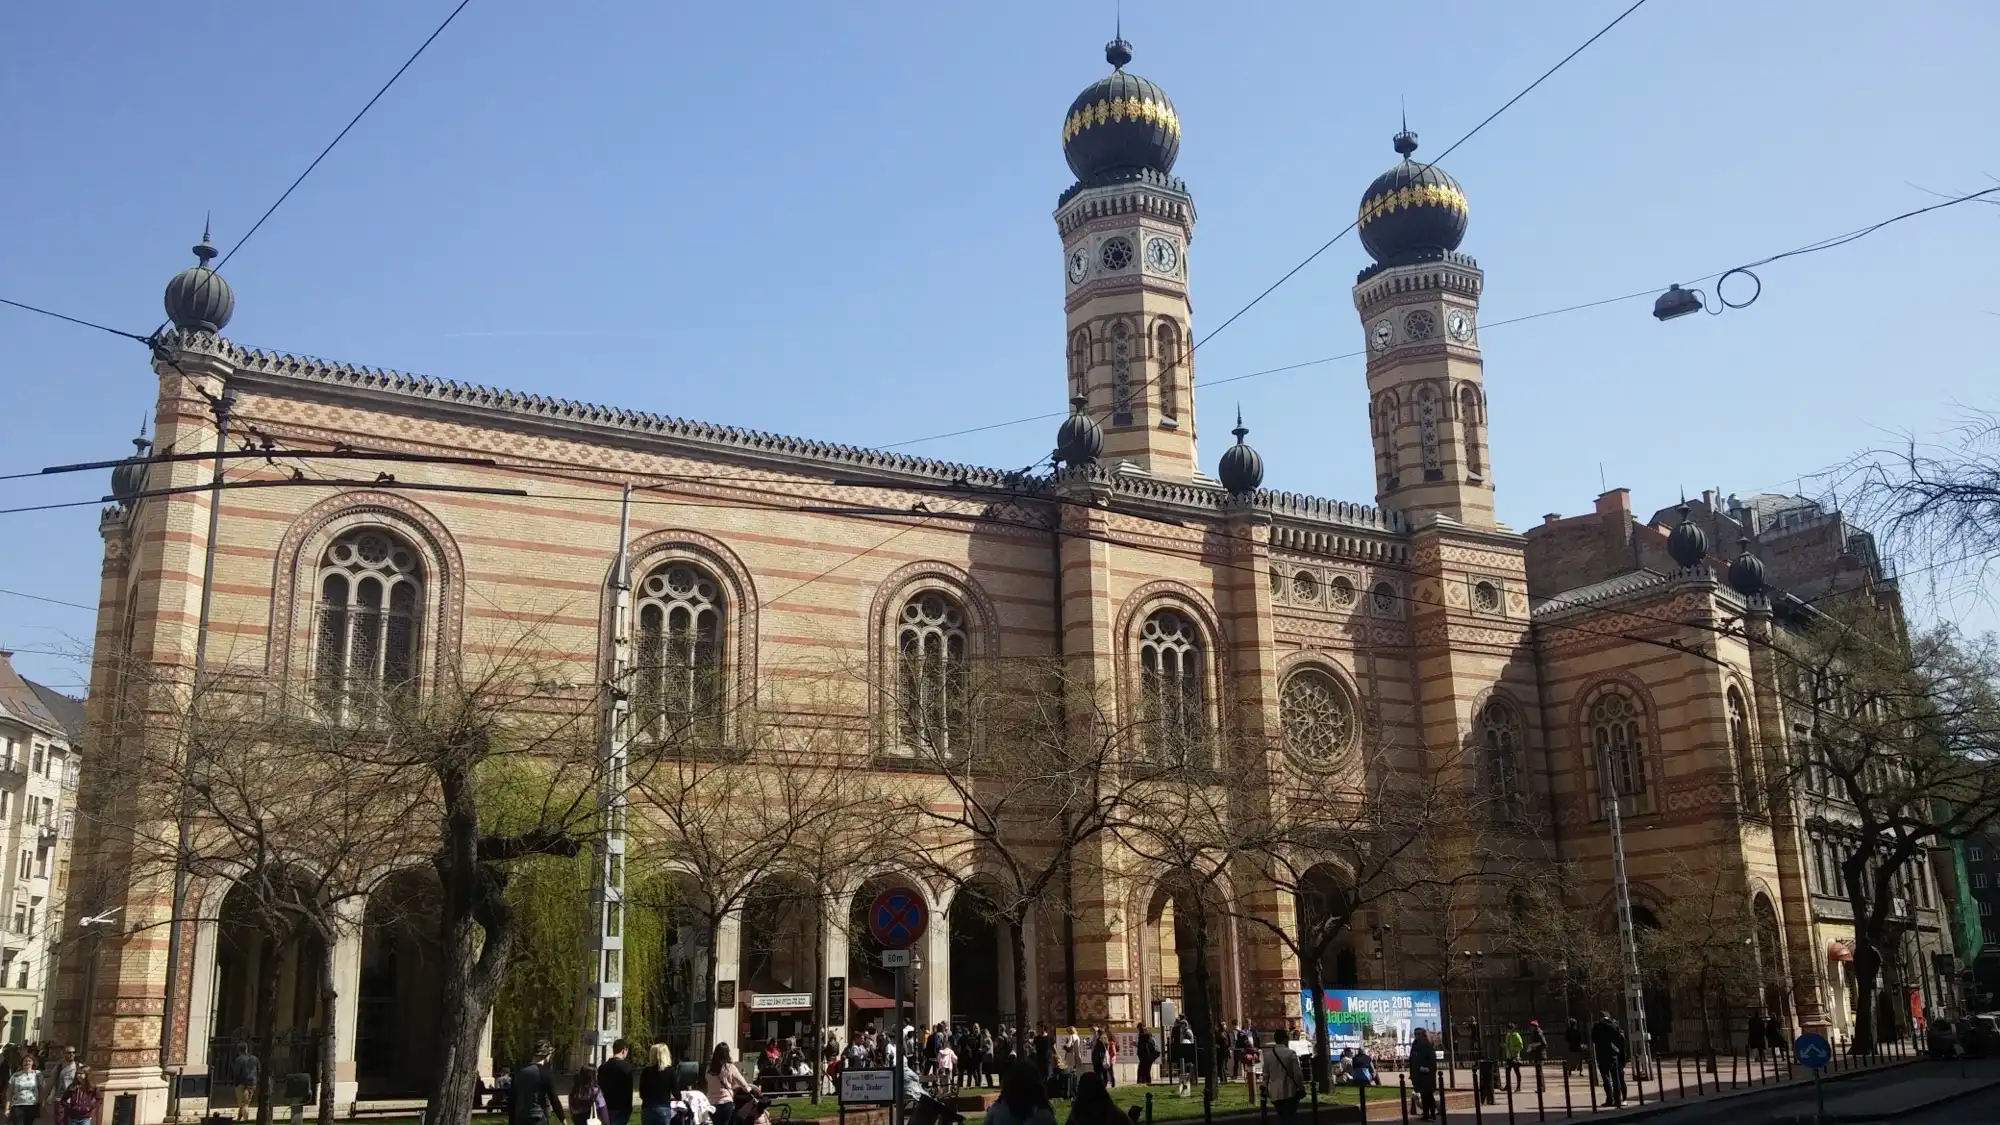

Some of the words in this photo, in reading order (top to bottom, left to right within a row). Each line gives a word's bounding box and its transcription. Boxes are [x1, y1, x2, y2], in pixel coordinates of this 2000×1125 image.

[1391, 996, 1412, 1008] 2016
[1396, 1018, 1410, 1044] 17
[1395, 1045, 1411, 1056] 16.0
